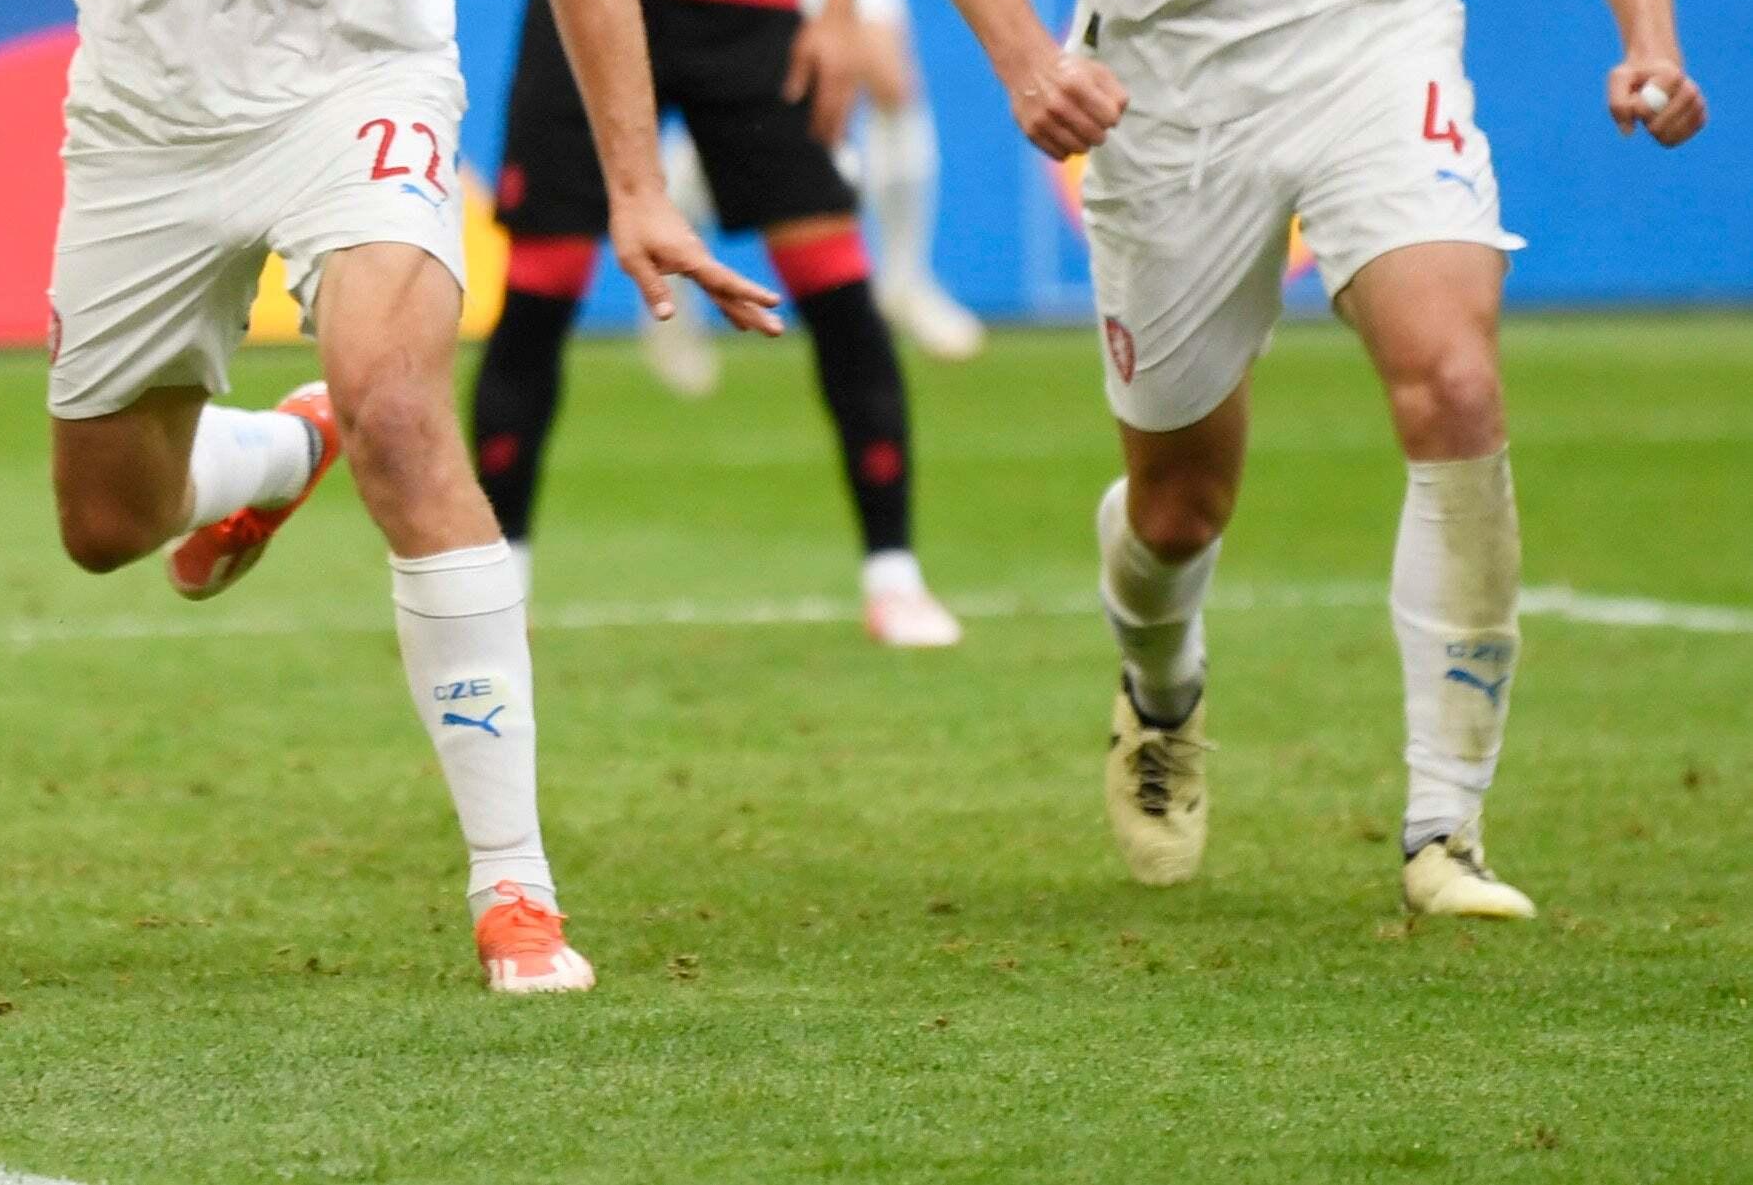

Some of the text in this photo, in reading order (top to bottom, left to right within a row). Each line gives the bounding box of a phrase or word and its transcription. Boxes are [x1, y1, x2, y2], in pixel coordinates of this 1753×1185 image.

[1422, 80, 1465, 155] 4
[356, 118, 449, 197] 22
[433, 678, 493, 701] CZE
